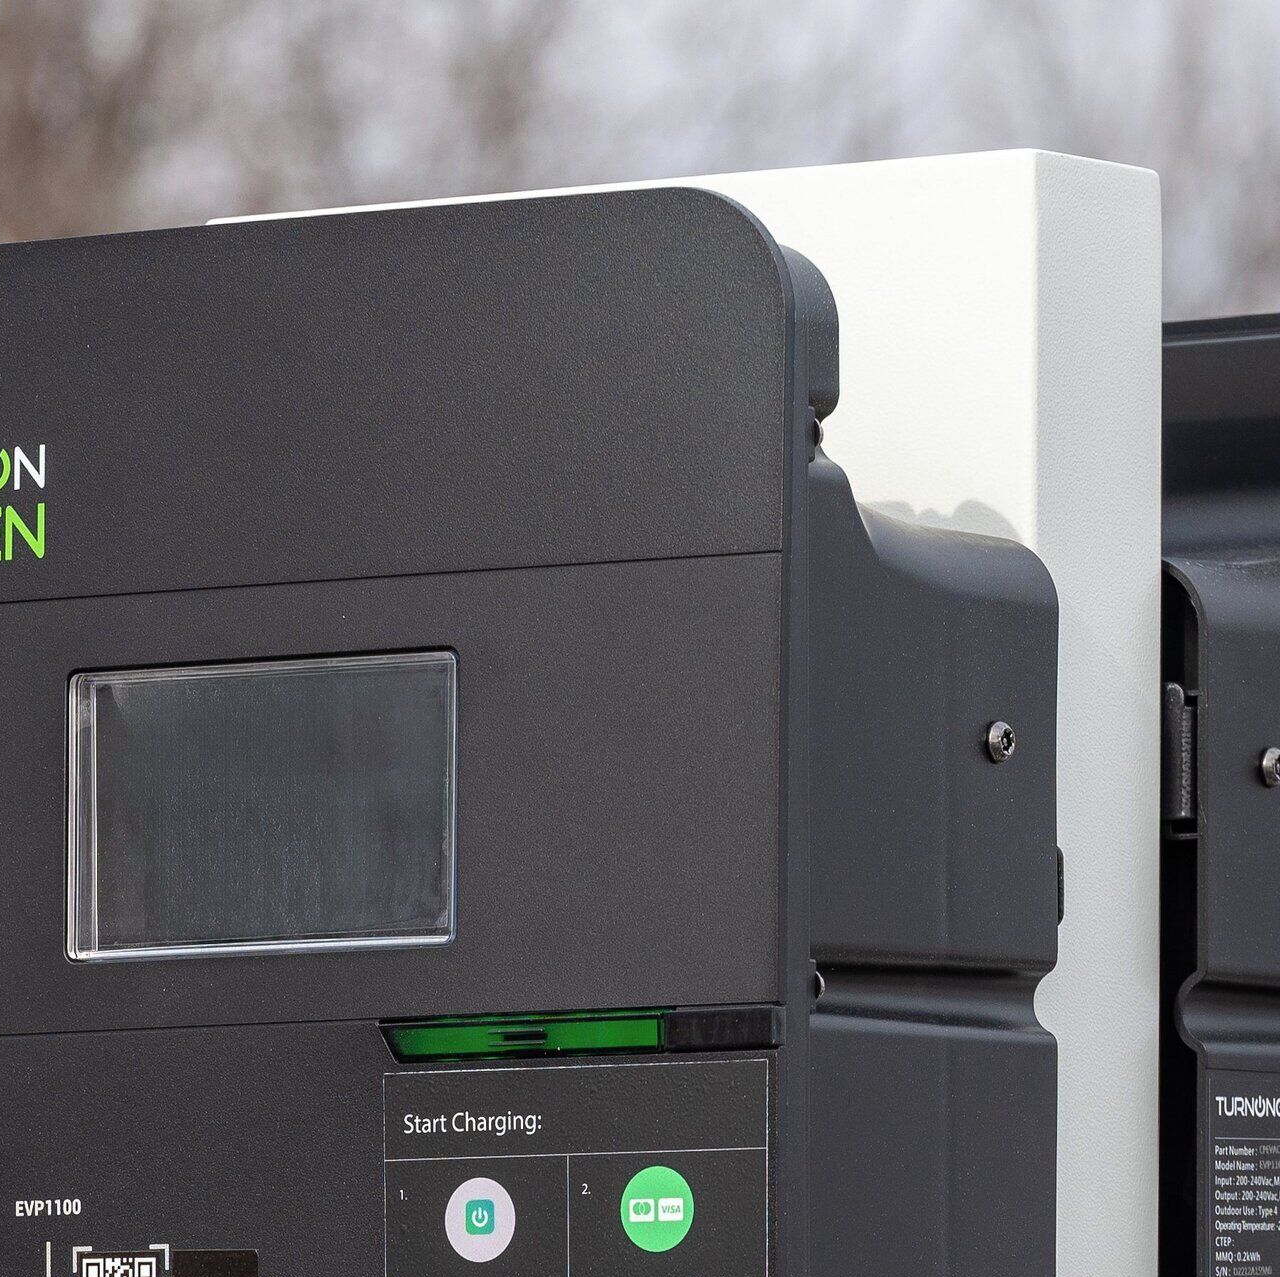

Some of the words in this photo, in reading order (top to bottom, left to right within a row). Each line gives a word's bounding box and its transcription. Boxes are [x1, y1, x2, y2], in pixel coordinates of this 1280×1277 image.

[403, 1113, 447, 1134] Start
[451, 1111, 542, 1137] Charging:
[1214, 1145, 1229, 1155] Part
[1214, 1160, 1236, 1171] Model
[399, 1189, 408, 1200] 1.
[581, 1183, 591, 1195] 2.
[15, 1198, 82, 1217] EVP1100
[661, 1205, 681, 1214] VISA
[1214, 1204, 1242, 1216] Outdoor
[1258, 1205, 1273, 1218] Type
[1273, 1205, 1278, 1216] 4
[1214, 1220, 1242, 1233] Operating
[1236, 1251, 1261, 1262] 0.2kWh
